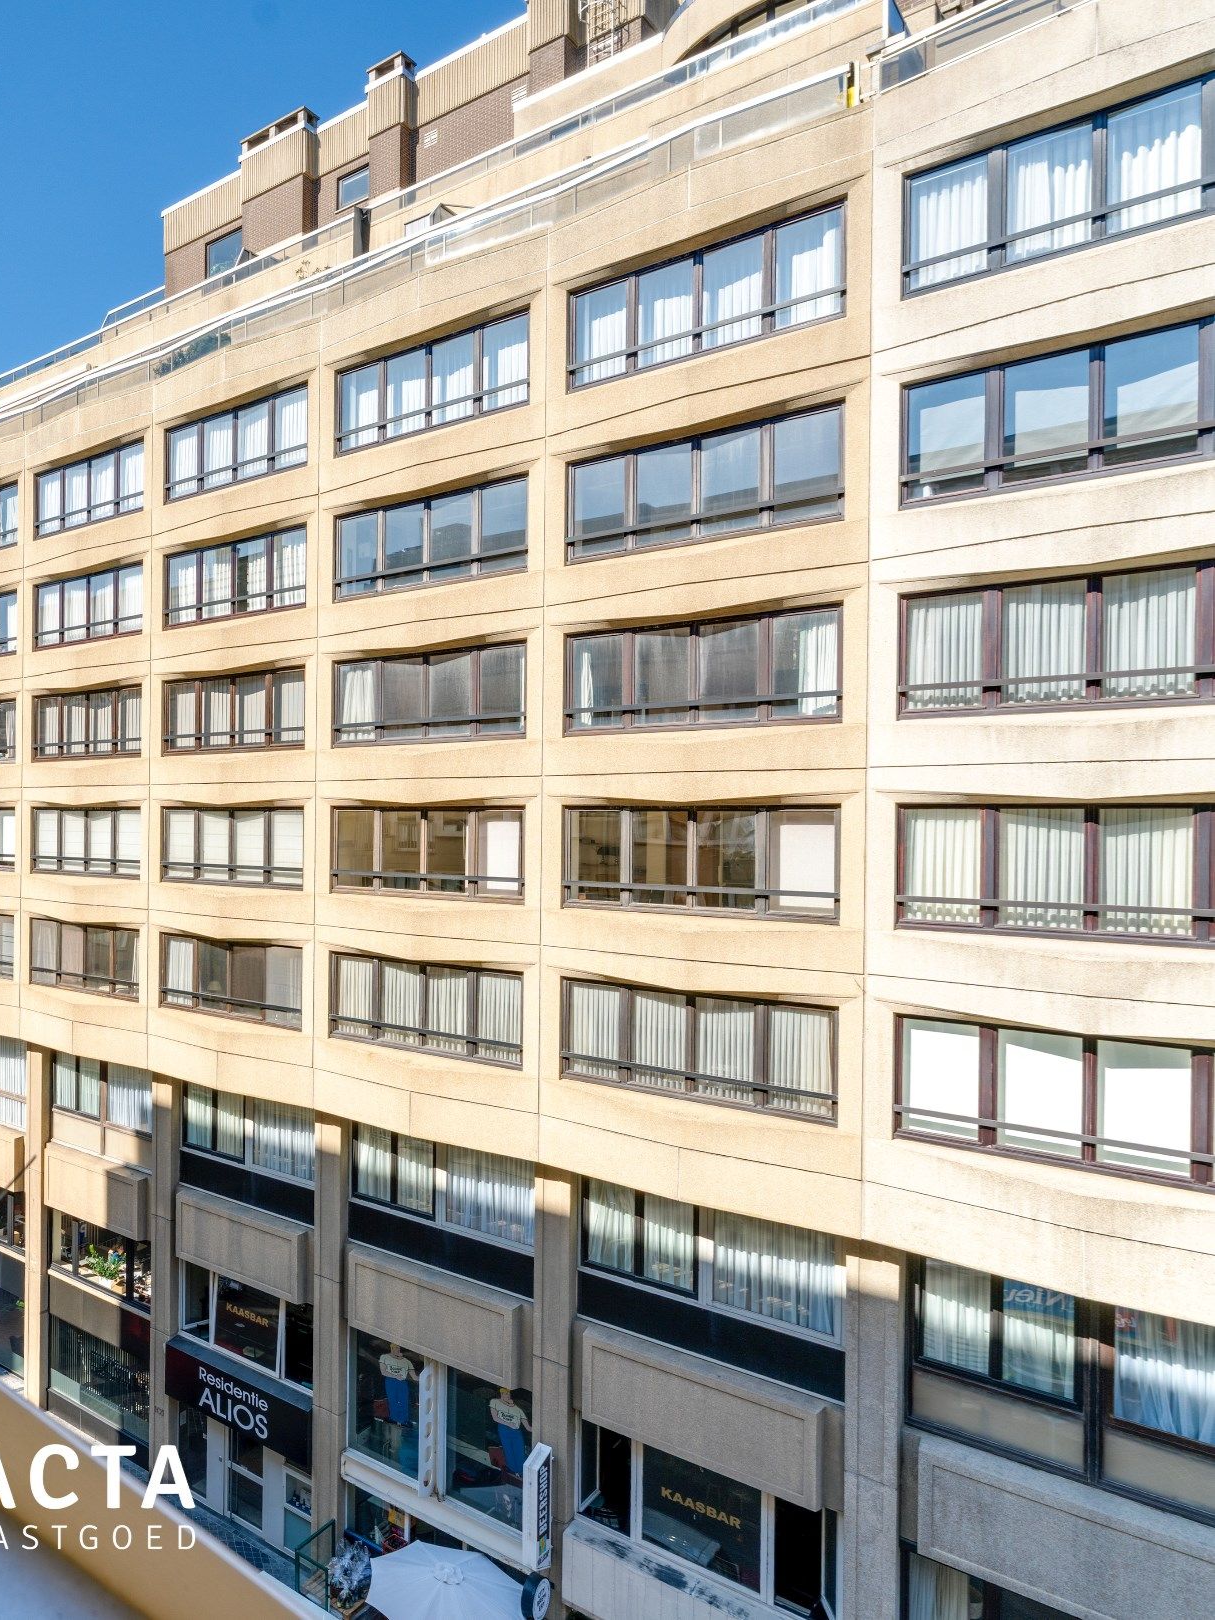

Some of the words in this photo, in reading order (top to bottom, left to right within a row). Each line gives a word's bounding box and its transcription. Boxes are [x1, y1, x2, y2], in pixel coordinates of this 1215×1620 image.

[226, 1302, 269, 1328] KAASBAR
[198, 1366, 269, 1412] Residentie
[198, 1387, 269, 1439] ALIOS
[538, 1464, 549, 1536] BEERSHOP
[660, 1486, 742, 1530] KAASBAR
